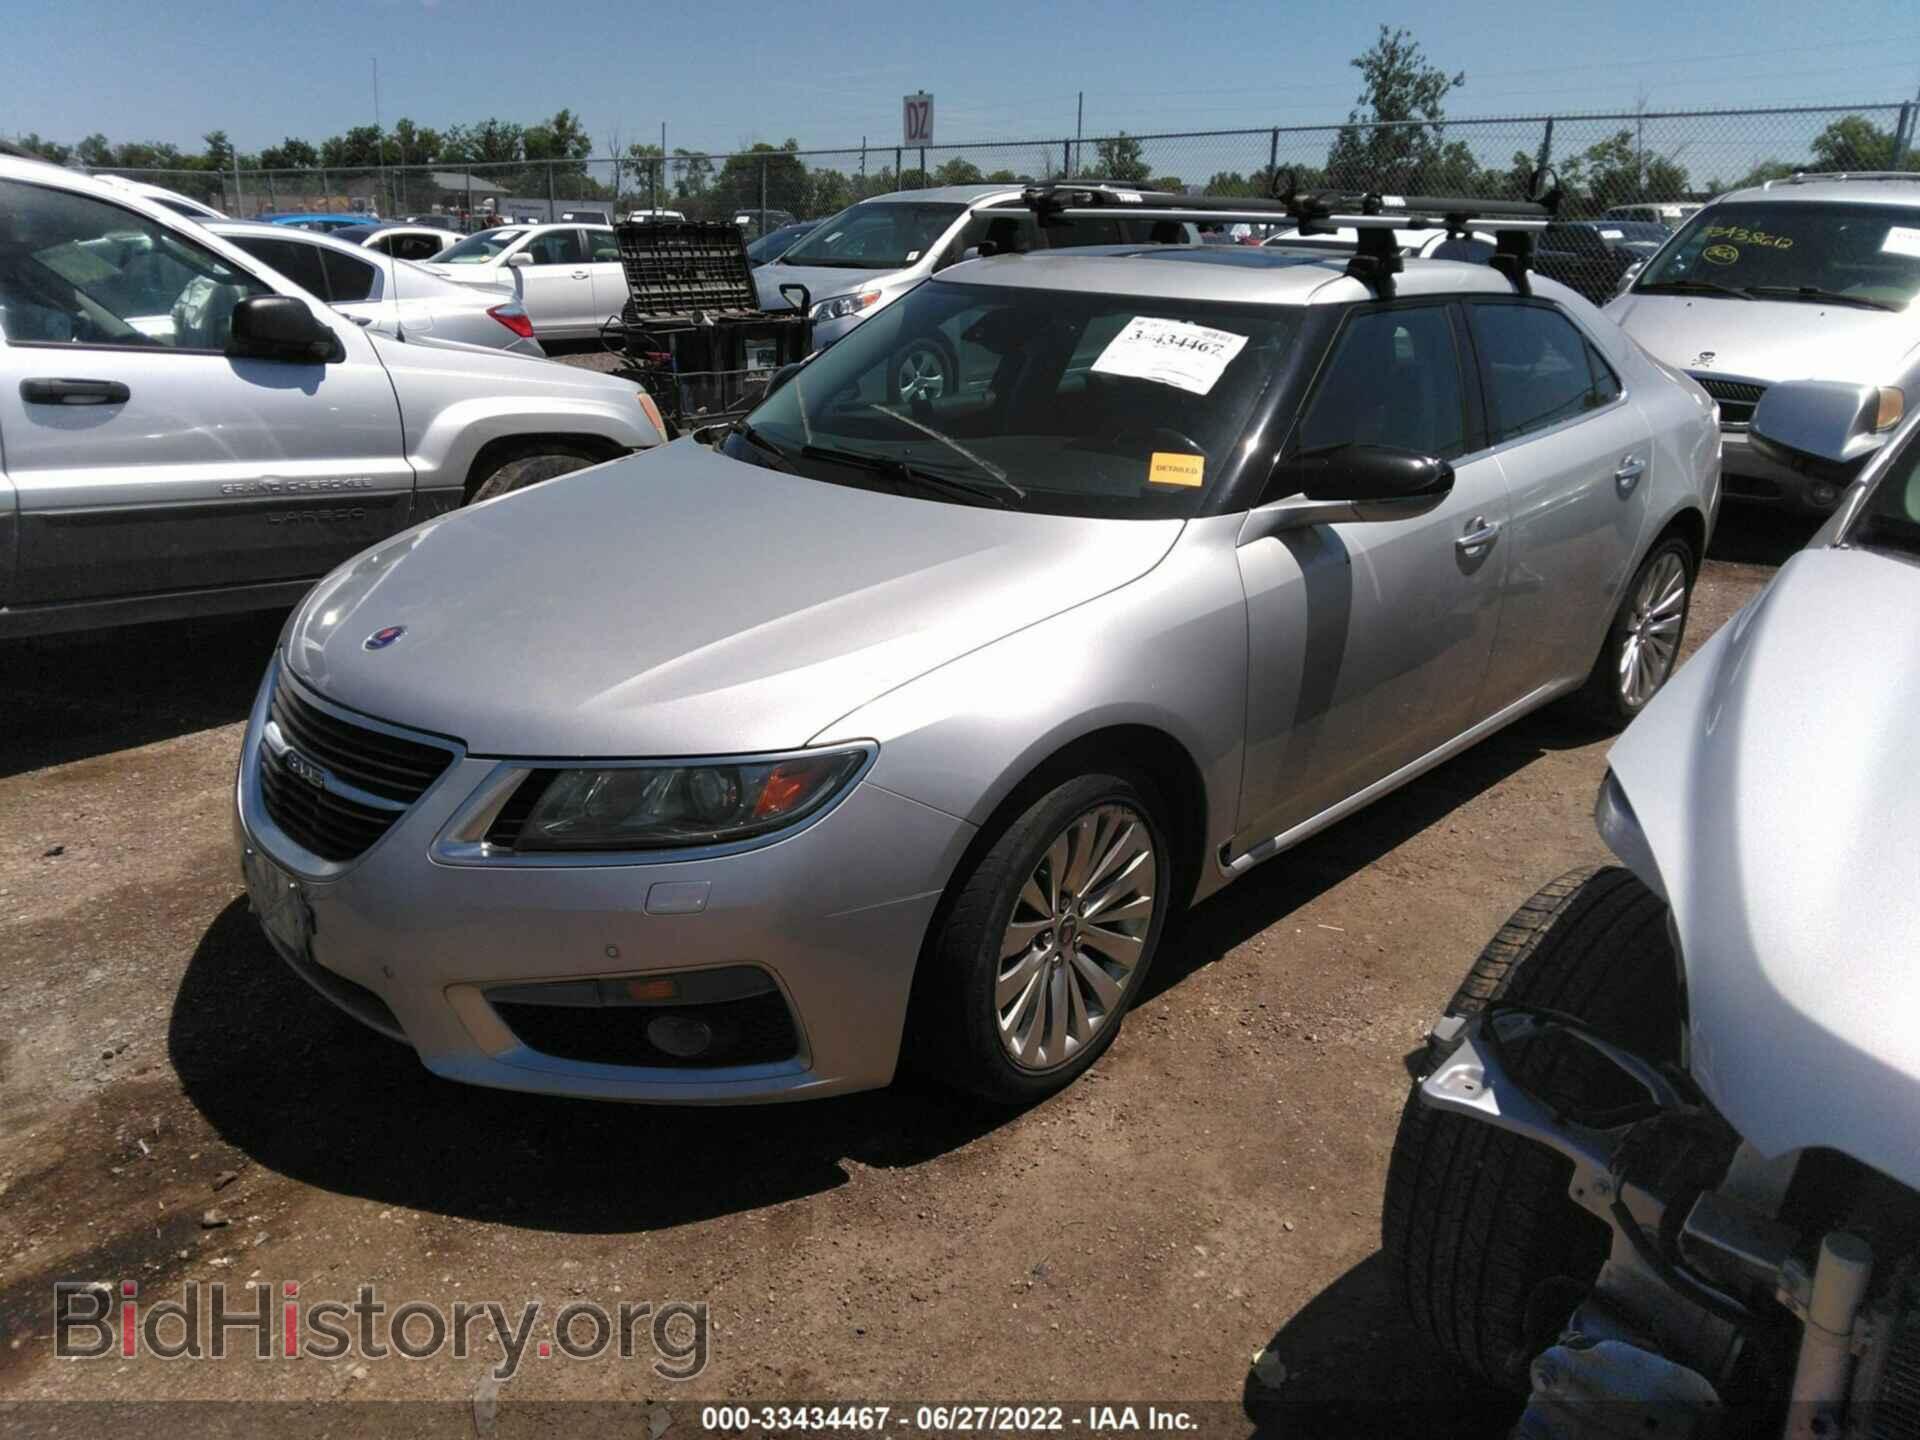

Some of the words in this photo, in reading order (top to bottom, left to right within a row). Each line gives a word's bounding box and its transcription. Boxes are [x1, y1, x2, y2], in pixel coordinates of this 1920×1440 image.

[1128, 330, 1225, 355] 3434467
[221, 482, 282, 496] GRAND
[287, 478, 373, 491] CHEROKEE
